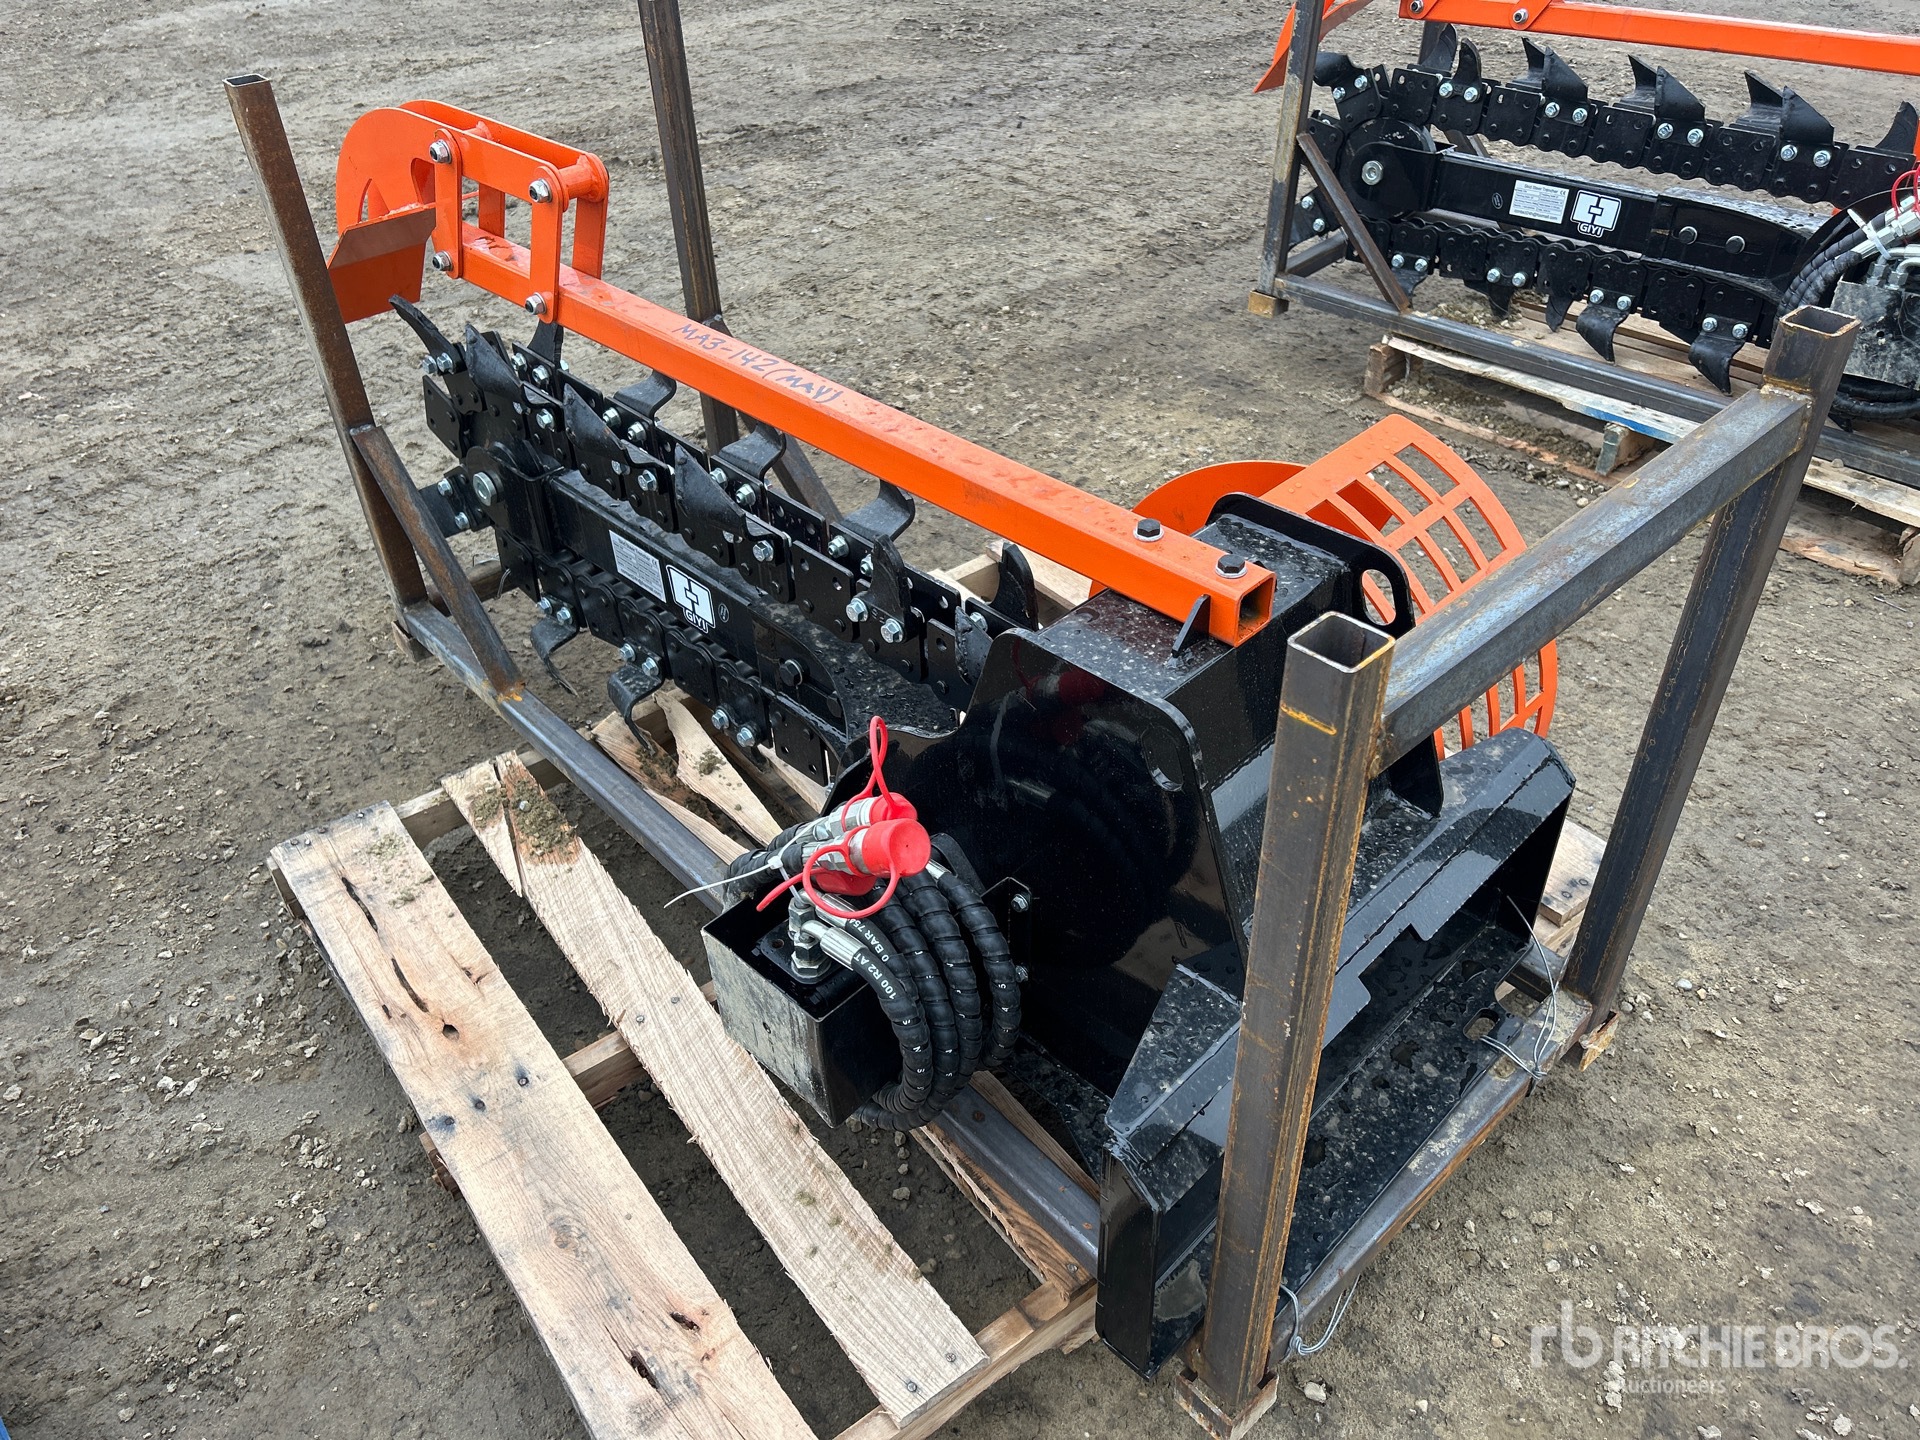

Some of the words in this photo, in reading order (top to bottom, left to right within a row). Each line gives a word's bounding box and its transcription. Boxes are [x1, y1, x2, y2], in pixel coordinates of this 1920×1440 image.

[1580, 223, 1602, 235] GIYI
[685, 611, 707, 630] GIYI
[864, 929, 885, 954] BAR
[853, 953, 870, 965] AT
[867, 963, 883, 980] R2
[881, 979, 897, 1000] 100
